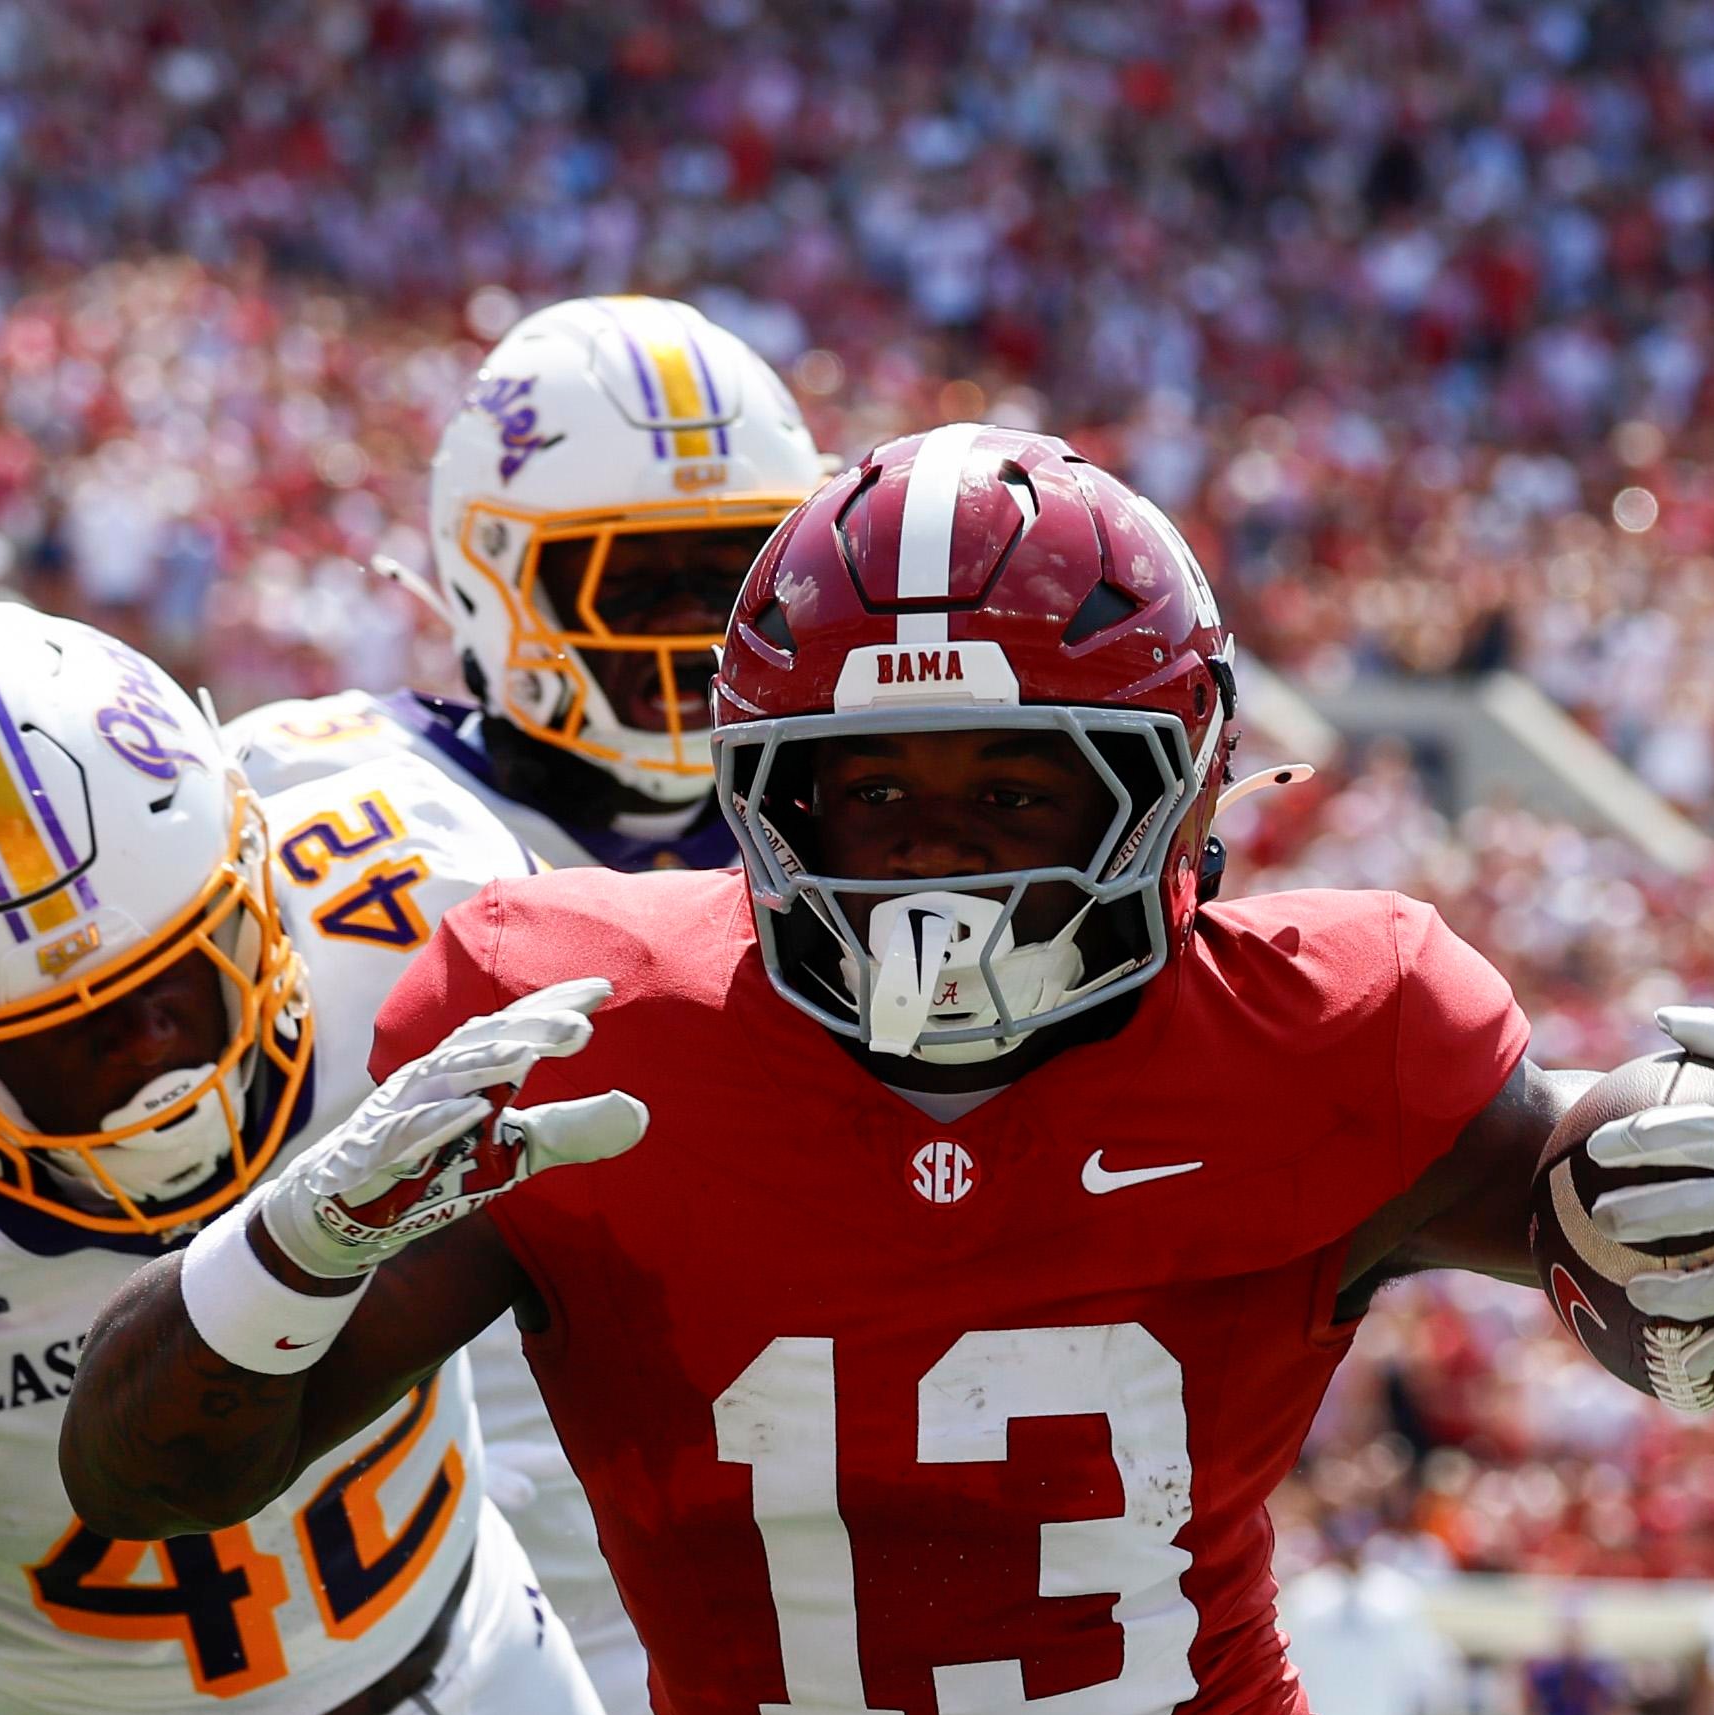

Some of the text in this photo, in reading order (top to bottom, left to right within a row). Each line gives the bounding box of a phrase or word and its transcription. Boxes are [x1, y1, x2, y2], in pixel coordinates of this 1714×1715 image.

[876, 650, 964, 685] BAMA
[272, 788, 432, 954] 42
[912, 1142, 974, 1203] SEC
[22, 1372, 467, 1698] 42
